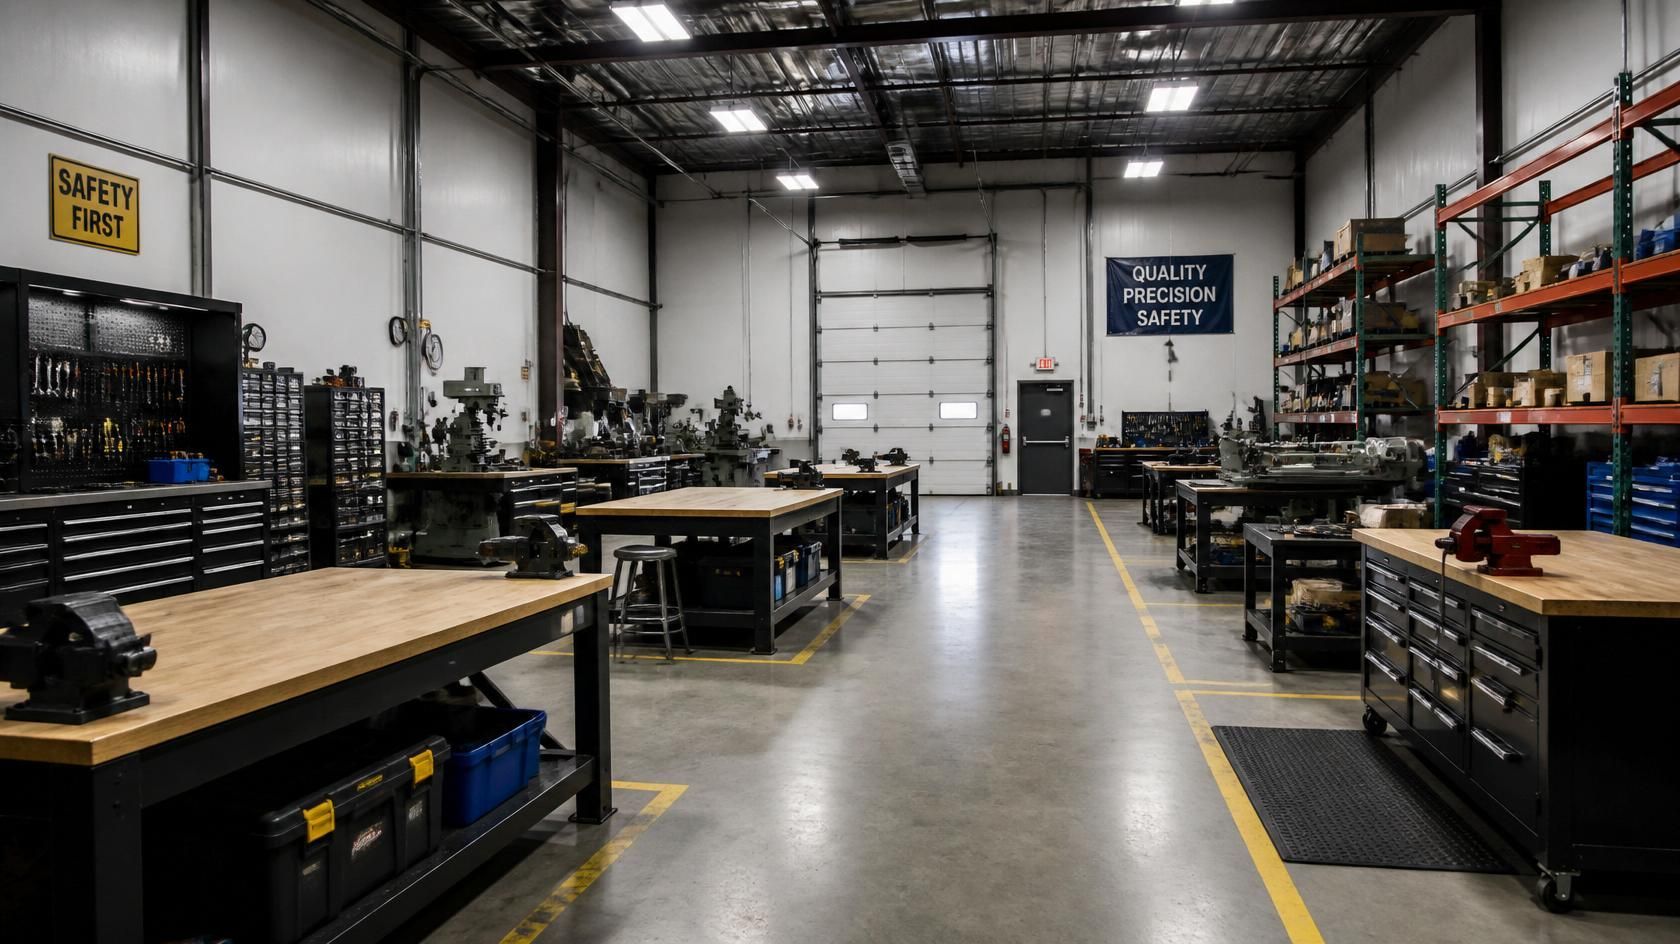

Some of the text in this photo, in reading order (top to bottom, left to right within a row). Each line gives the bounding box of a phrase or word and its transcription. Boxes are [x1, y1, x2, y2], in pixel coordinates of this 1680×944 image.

[58, 168, 133, 210] SAFETY
[72, 205, 124, 239] FIRST
[1132, 264, 1206, 282] QUALITY
[1123, 286, 1216, 304] PRECISION
[1137, 309, 1203, 326] SAFETY
